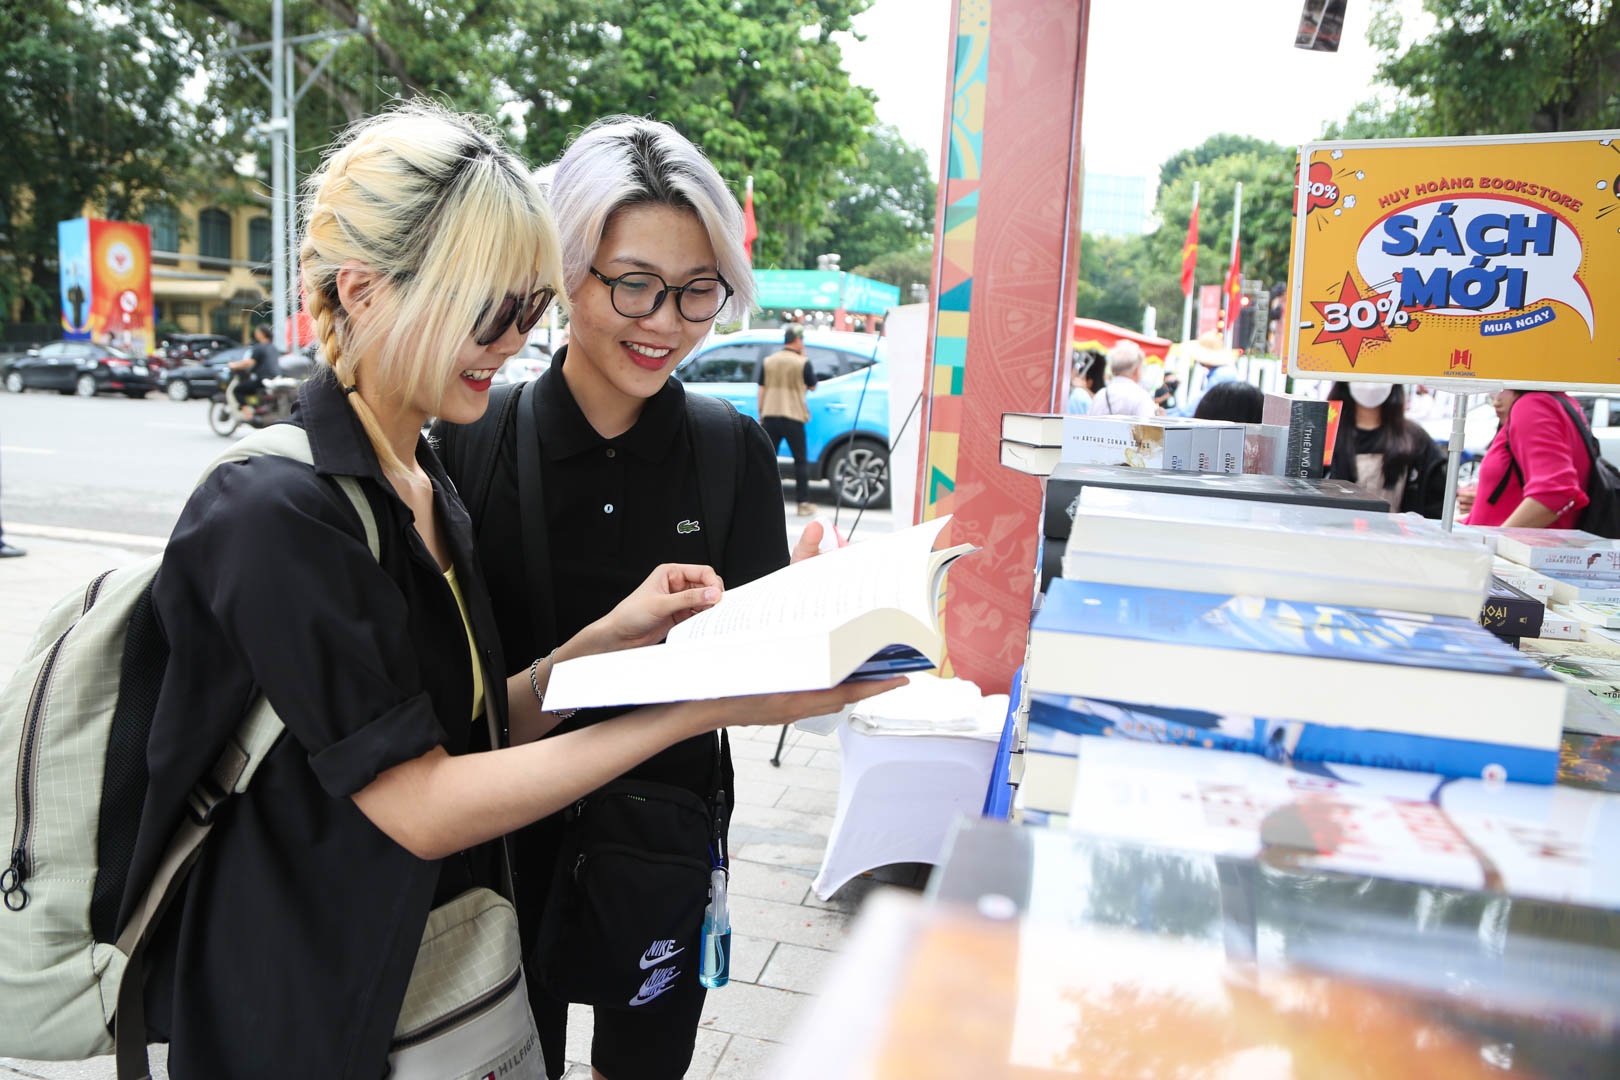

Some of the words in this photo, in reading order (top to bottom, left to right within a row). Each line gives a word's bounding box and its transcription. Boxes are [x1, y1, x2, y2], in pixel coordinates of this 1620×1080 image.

[1378, 187, 1410, 208] HUY
[1415, 177, 1474, 196] HOÀNG
[1479, 177, 1584, 213] BOOKSTORE
[1382, 203, 1557, 256] SÁCH
[1400, 255, 1528, 310] MỚI
[1484, 321, 1513, 334] MUA
[1515, 310, 1550, 329] NGAY
[1082, 435, 1105, 444] ARTHUR
[1107, 438, 1127, 446] CONAN
[646, 939, 677, 957] NIKE
